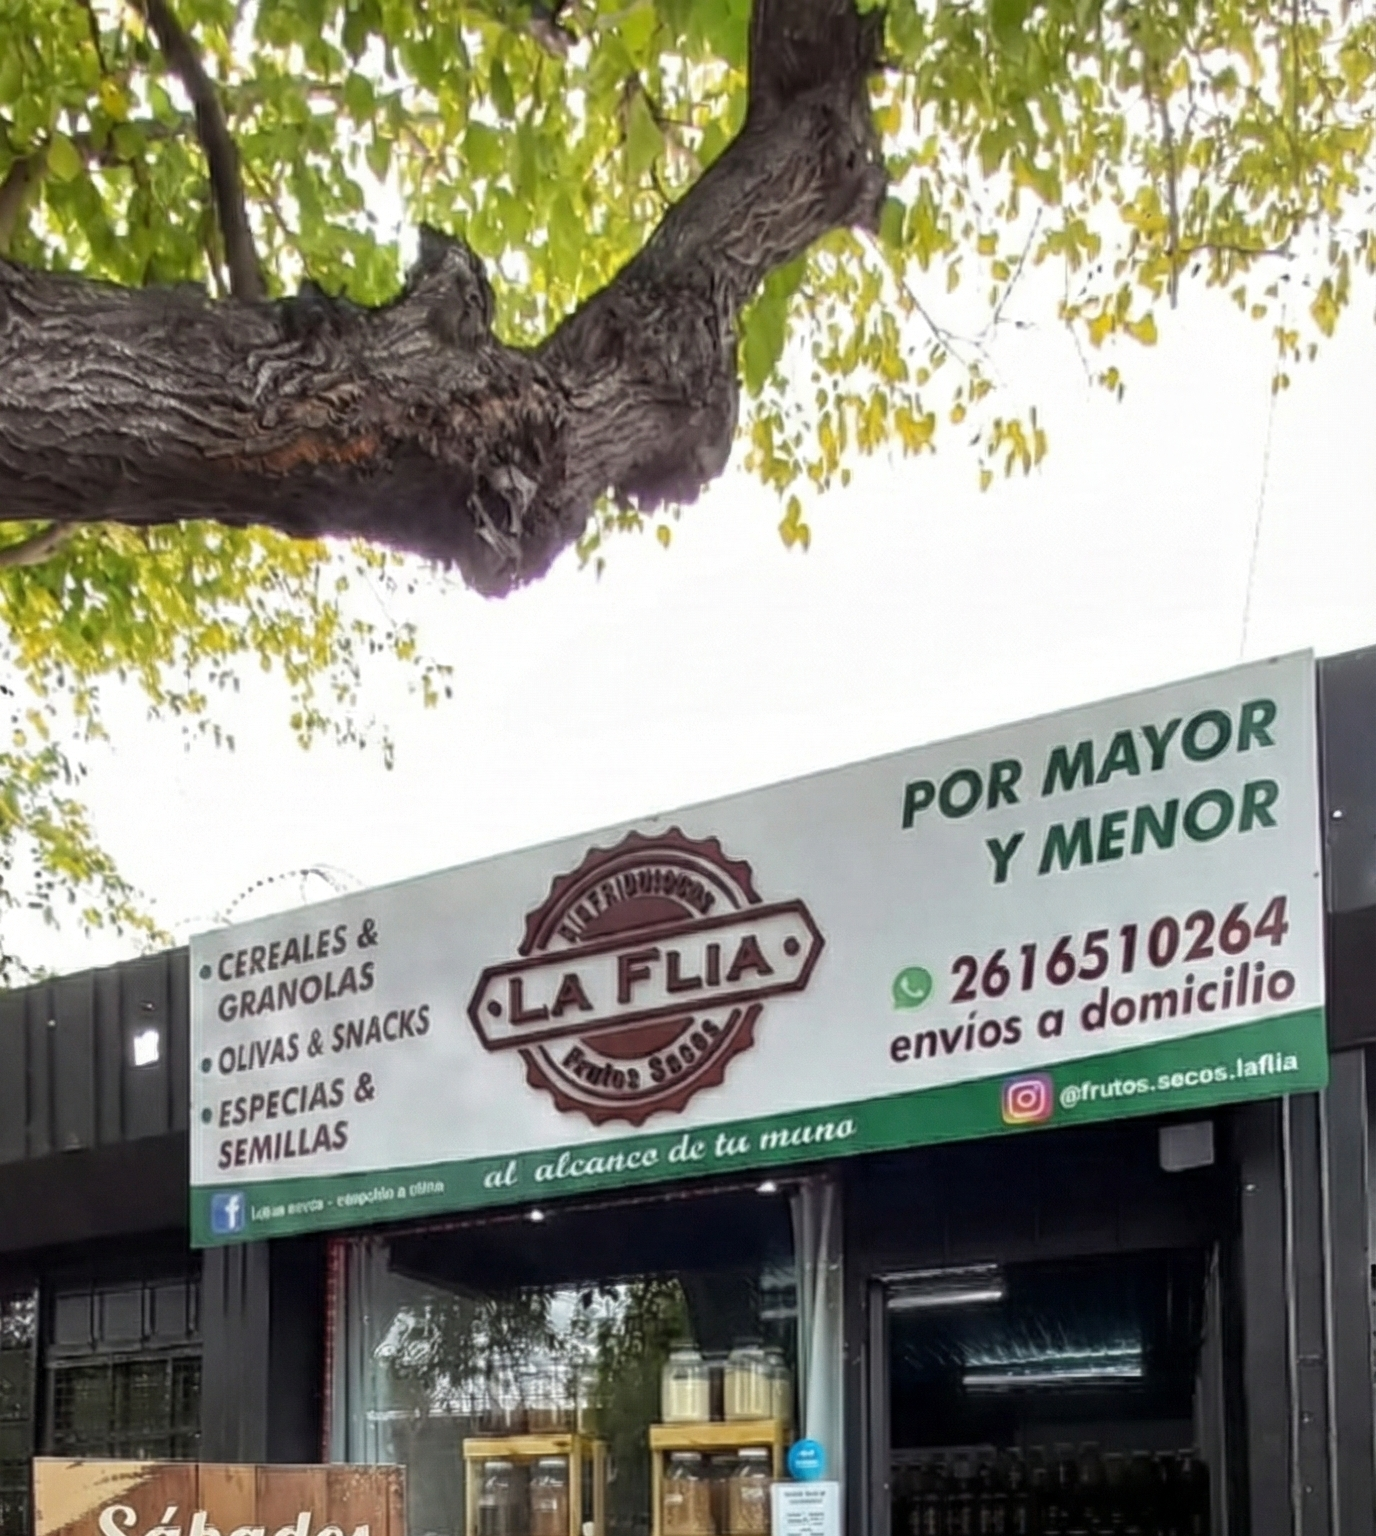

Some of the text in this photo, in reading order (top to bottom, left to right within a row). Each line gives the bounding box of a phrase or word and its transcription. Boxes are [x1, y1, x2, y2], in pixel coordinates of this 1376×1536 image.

[902, 698, 1278, 829] POR MAYOR
[987, 778, 1280, 884] Y MENOR
[218, 918, 378, 981] CEREALES &
[508, 935, 774, 1025] LA FLIA
[950, 895, 1289, 1004] 2616510264
[218, 962, 374, 1021] GRANOLAS
[890, 960, 1296, 1063] envíos a domicilio
[218, 1005, 430, 1074] OLIVAS & SNACKS
[219, 1072, 374, 1127] ESPECIAS &
[1059, 1052, 1299, 1109] @frutos.secos.laflia
[218, 1120, 348, 1168] SEMILLAS
[483, 1160, 518, 1188] al
[668, 1134, 706, 1163] de
[714, 1133, 750, 1156] tu
[760, 1118, 856, 1151] mano
